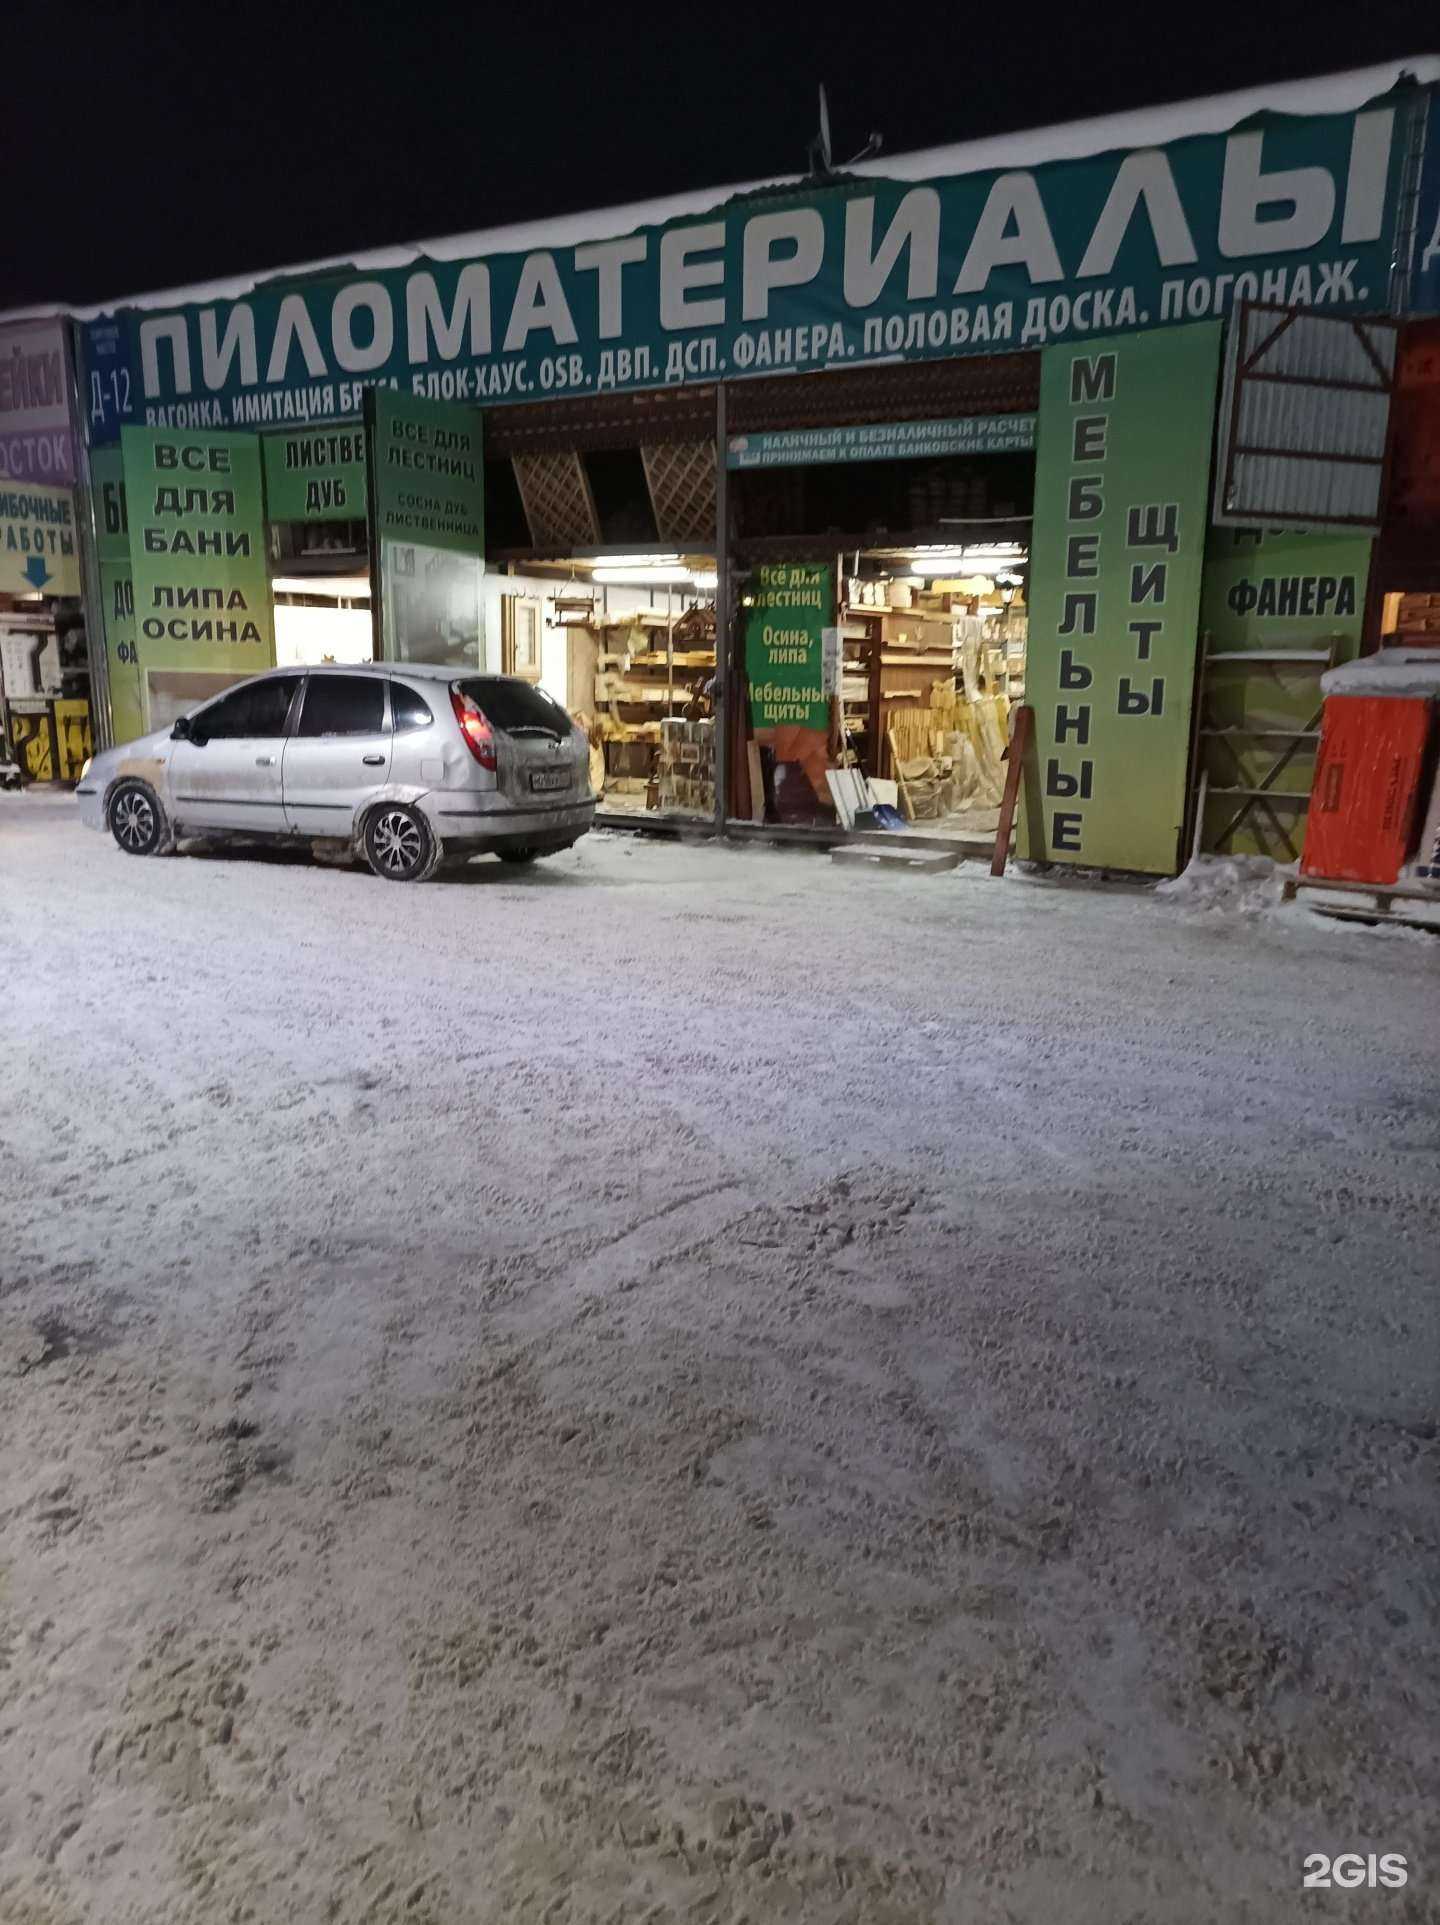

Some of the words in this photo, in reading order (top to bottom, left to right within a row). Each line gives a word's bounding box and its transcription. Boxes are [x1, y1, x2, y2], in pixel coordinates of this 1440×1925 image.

[138, 107, 1396, 399] ПИЛОМАТЕРИАЛЫ
[232, 384, 334, 423] ИМИТАЦИЯ
[412, 361, 534, 400] БЛОК-ХАУС.
[540, 355, 592, 387] OSB.
[598, 345, 659, 391] ДВП.
[664, 337, 726, 383] ДСП.
[733, 322, 855, 368] ФАНЕРА.
[863, 302, 1013, 353] ПОЛОВАЯ
[1021, 285, 1149, 344] ДОСКА.
[1160, 258, 1369, 320] ПОГОНАЖ.
[91, 366, 133, 425] Д-12
[392, 419, 430, 443] ВСЕ
[434, 428, 471, 451] ДЛЯ
[763, 429, 842, 450] НАЛИЧНЫЙ
[846, 433, 855, 444] И
[859, 421, 974, 444] БЕЗНАЛИЧНЫЙ
[977, 417, 1037, 434] РАСЧЕТ
[154, 444, 232, 473] ВСЕ
[387, 447, 476, 481] ЛЕСТНИЦ
[762, 449, 836, 464] ПРИНИМАЕМ
[838, 447, 848, 459] К
[850, 444, 895, 458] ОПЛАТЕ
[898, 438, 984, 455] БАНКОВСКИЕ
[987, 435, 1034, 450] КАРТЫ
[154, 488, 235, 517] ДЛЯ
[306, 479, 346, 514] ДУБ
[397, 493, 441, 512] СОСНА
[444, 500, 469, 516] ДУБ
[385, 512, 479, 536] ЛИСТВЕННИЦА
[0, 525, 74, 555] АБОТЫ
[144, 528, 252, 557] БАНИ
[760, 564, 787, 586] Всё
[152, 587, 249, 612] ЛИПА
[1047, 354, 1117, 850] МЕБЕЛЬНЫЕ
[1117, 504, 1180, 717] ЩИТЫ
[1227, 575, 1357, 617] ФАНЕРА
[142, 617, 262, 643] ОСИНА
[762, 625, 815, 648] Осина,
[768, 646, 808, 665] липа
[763, 701, 811, 723] щиты
